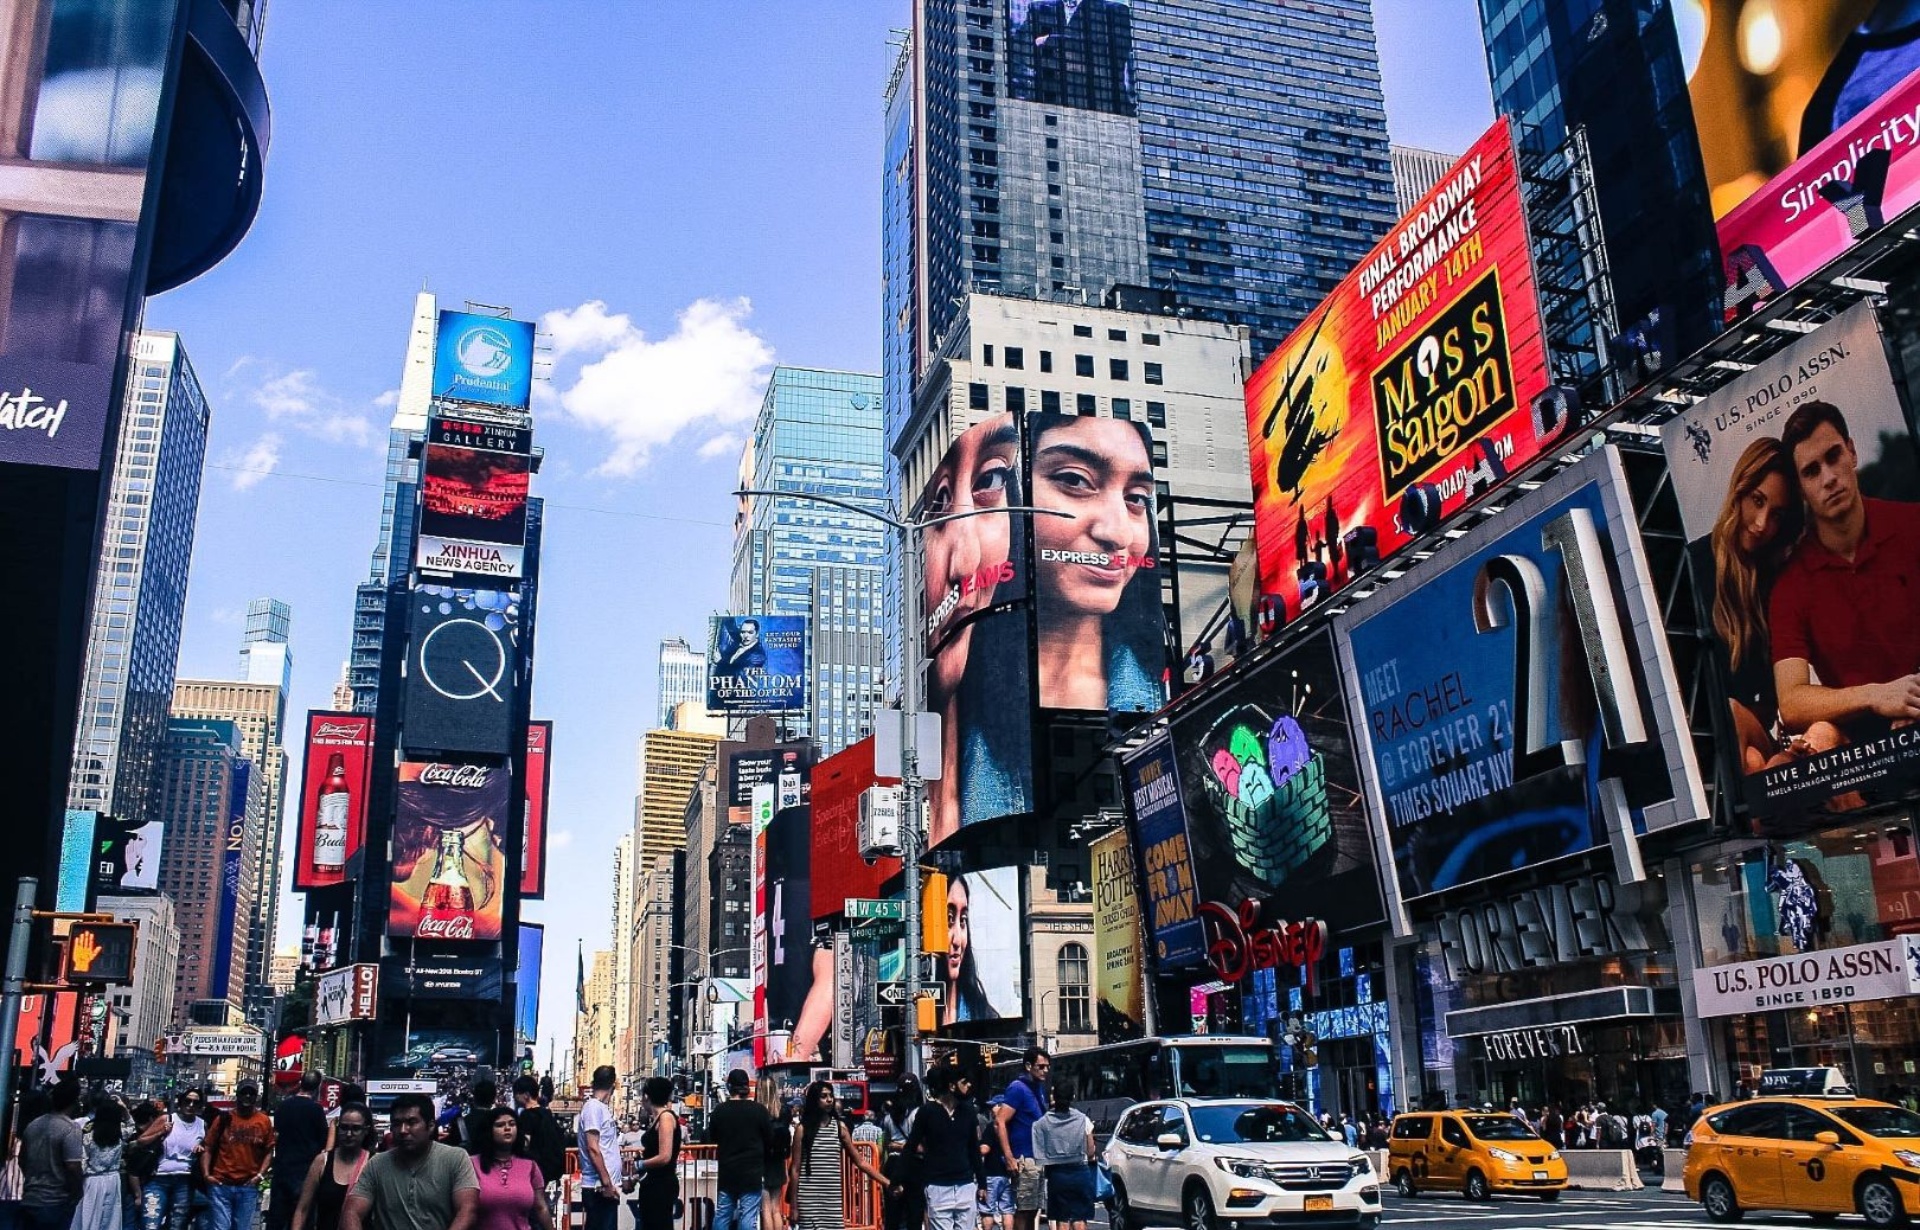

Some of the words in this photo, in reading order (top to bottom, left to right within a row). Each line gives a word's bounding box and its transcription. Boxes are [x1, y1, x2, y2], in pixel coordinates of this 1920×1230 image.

[1780, 104, 1920, 223] Simplicity
[1359, 245, 1398, 299] FINAL
[1399, 153, 1484, 258] BROADWAY
[1371, 198, 1478, 320] PERFORMANCE
[1376, 271, 1439, 353] JANUARY
[1443, 231, 1484, 286] 14TH
[455, 374, 510, 391] Prudential
[1715, 406, 1745, 432] U.S.
[1746, 375, 1793, 413] POLO
[1797, 342, 1851, 385] ASSN.
[1388, 357, 1506, 479] Saigon
[1745, 407, 1781, 433] SINCE
[1786, 385, 1818, 408] 1890
[443, 433, 516, 449] GALLERY
[484, 427, 517, 438] XINHUA
[426, 555, 462, 569] NEWS
[464, 560, 515, 573] AGENCY
[440, 544, 502, 562] XINHUA
[1041, 549, 1110, 566] EXPRESS
[928, 583, 960, 636] EXPRESS
[708, 675, 802, 691] PHANTOM
[744, 667, 766, 676] THE
[1364, 657, 1400, 707] MEET
[717, 689, 732, 698] OF
[735, 689, 757, 698] THE
[757, 688, 794, 698] OPERA
[1373, 671, 1473, 744] RACHEL
[1397, 712, 1480, 780] FOREVER
[738, 759, 757, 767] Show
[420, 763, 488, 788] Coca-Cola
[744, 774, 764, 782] berry
[783, 778, 796, 787] bai
[1147, 772, 1176, 803] MUSICAL
[1765, 767, 1799, 786] LIVE
[1389, 784, 1432, 828] TIMES
[1434, 762, 1490, 816] SQUARE
[1145, 833, 1187, 874] COME
[1147, 861, 1192, 901] FROM
[858, 902, 870, 916] W
[875, 902, 889, 916] 45
[418, 915, 474, 939] Coca-Cola
[851, 928, 877, 939] George
[1048, 922, 1067, 931] THE
[1434, 872, 1640, 981] FOREVER
[1714, 968, 1753, 995] U.S.
[1756, 958, 1820, 990] POLO
[1826, 948, 1901, 981] ASSN.
[886, 988, 905, 1000] ONE
[1755, 991, 1805, 1008] SINCE
[1811, 985, 1855, 1001] 1890
[1483, 1025, 1560, 1062] FOREVER
[1562, 1024, 1584, 1056] 21
